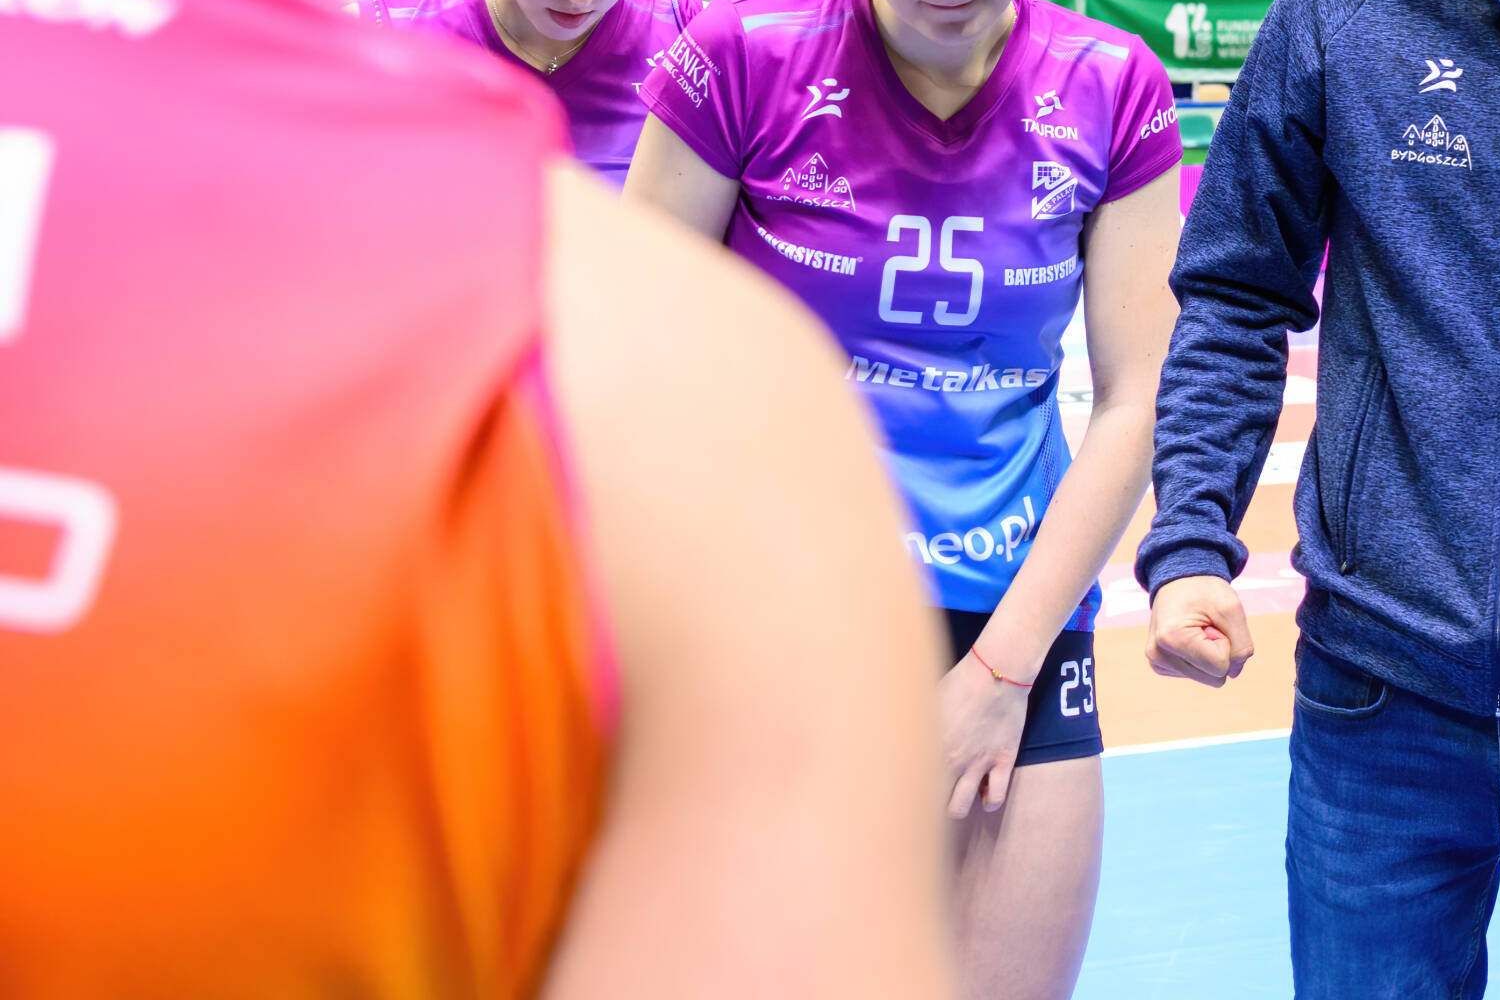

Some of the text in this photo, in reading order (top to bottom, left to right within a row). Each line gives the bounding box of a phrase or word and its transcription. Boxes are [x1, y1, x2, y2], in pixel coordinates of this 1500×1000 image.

[1021, 118, 1078, 140] TAURON
[1391, 150, 1468, 168] BYDGOSZCZ
[878, 215, 984, 326] 25
[845, 356, 1050, 392] Metalkas
[1060, 657, 1093, 716] 25
